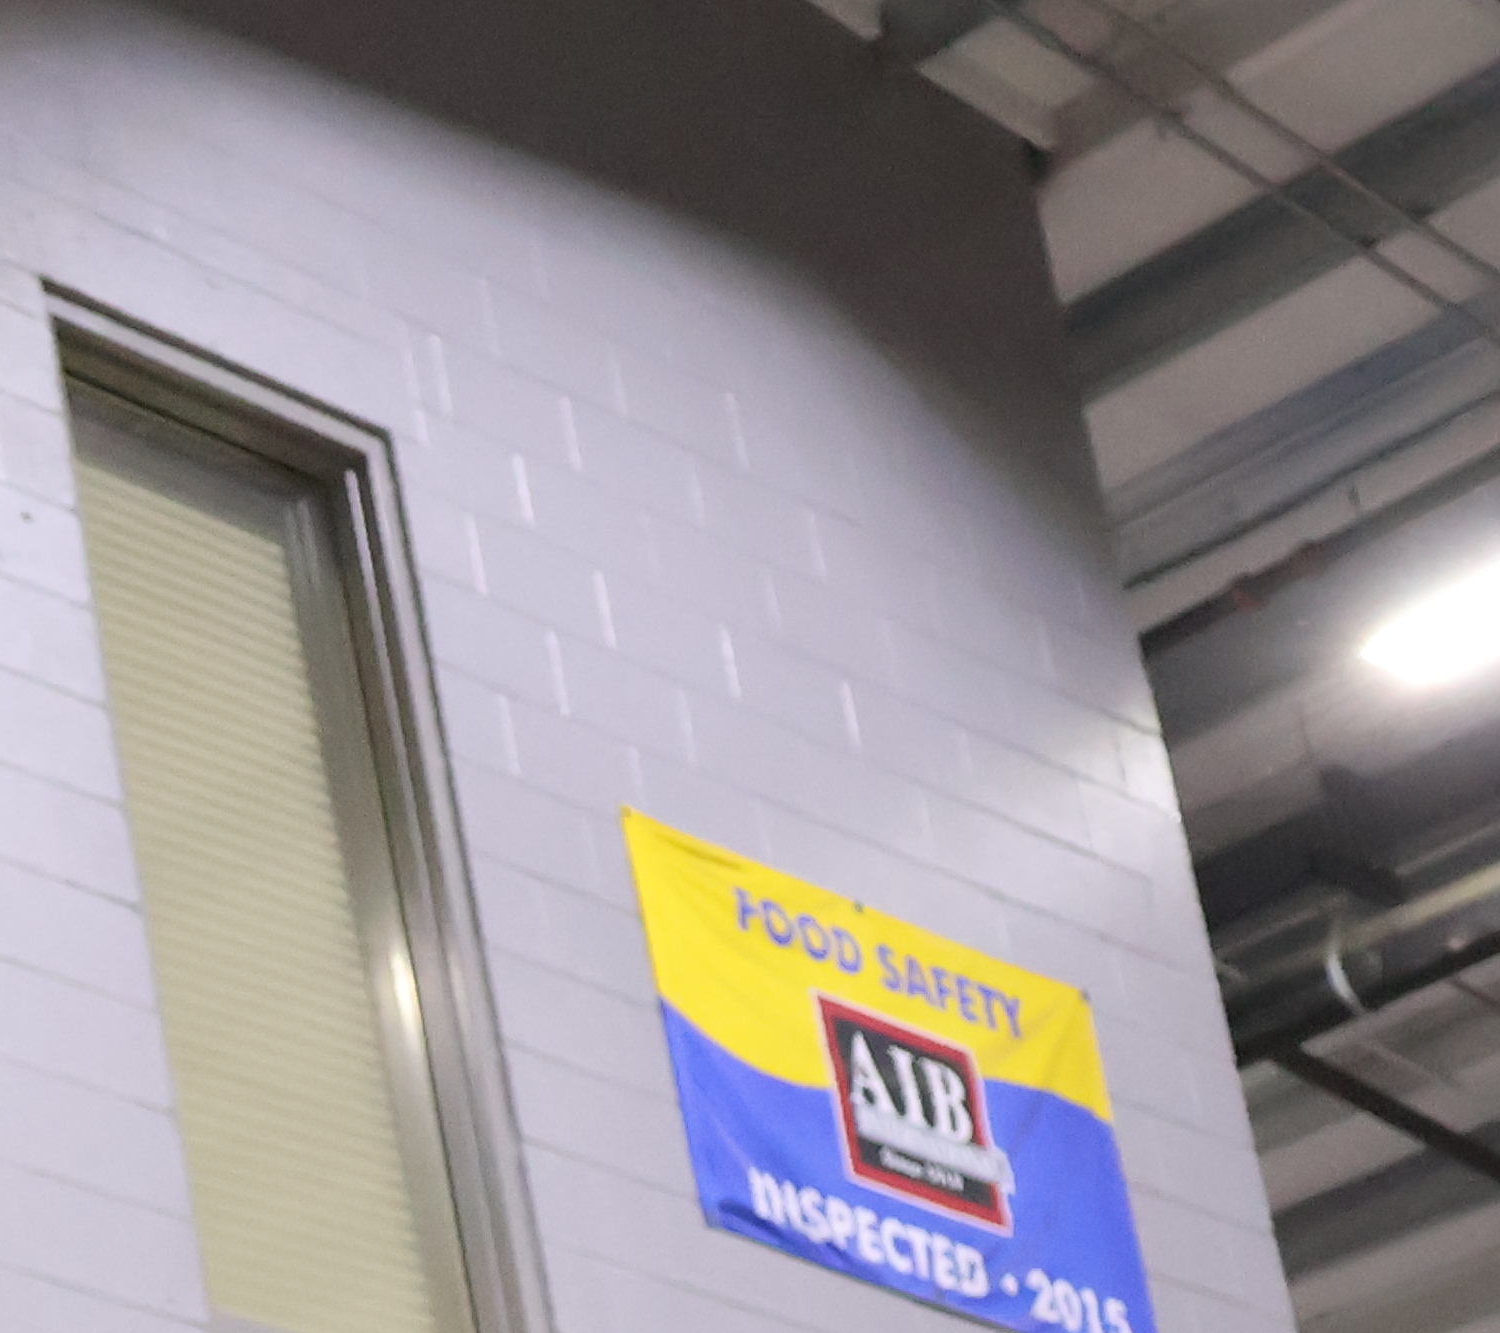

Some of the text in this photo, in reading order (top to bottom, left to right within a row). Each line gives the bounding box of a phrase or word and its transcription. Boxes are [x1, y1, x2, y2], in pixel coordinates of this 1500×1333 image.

[734, 886, 1022, 1040] FOOD SAFETY
[851, 1030, 974, 1144] AIB
[747, 1166, 991, 1299] INSPECTED
